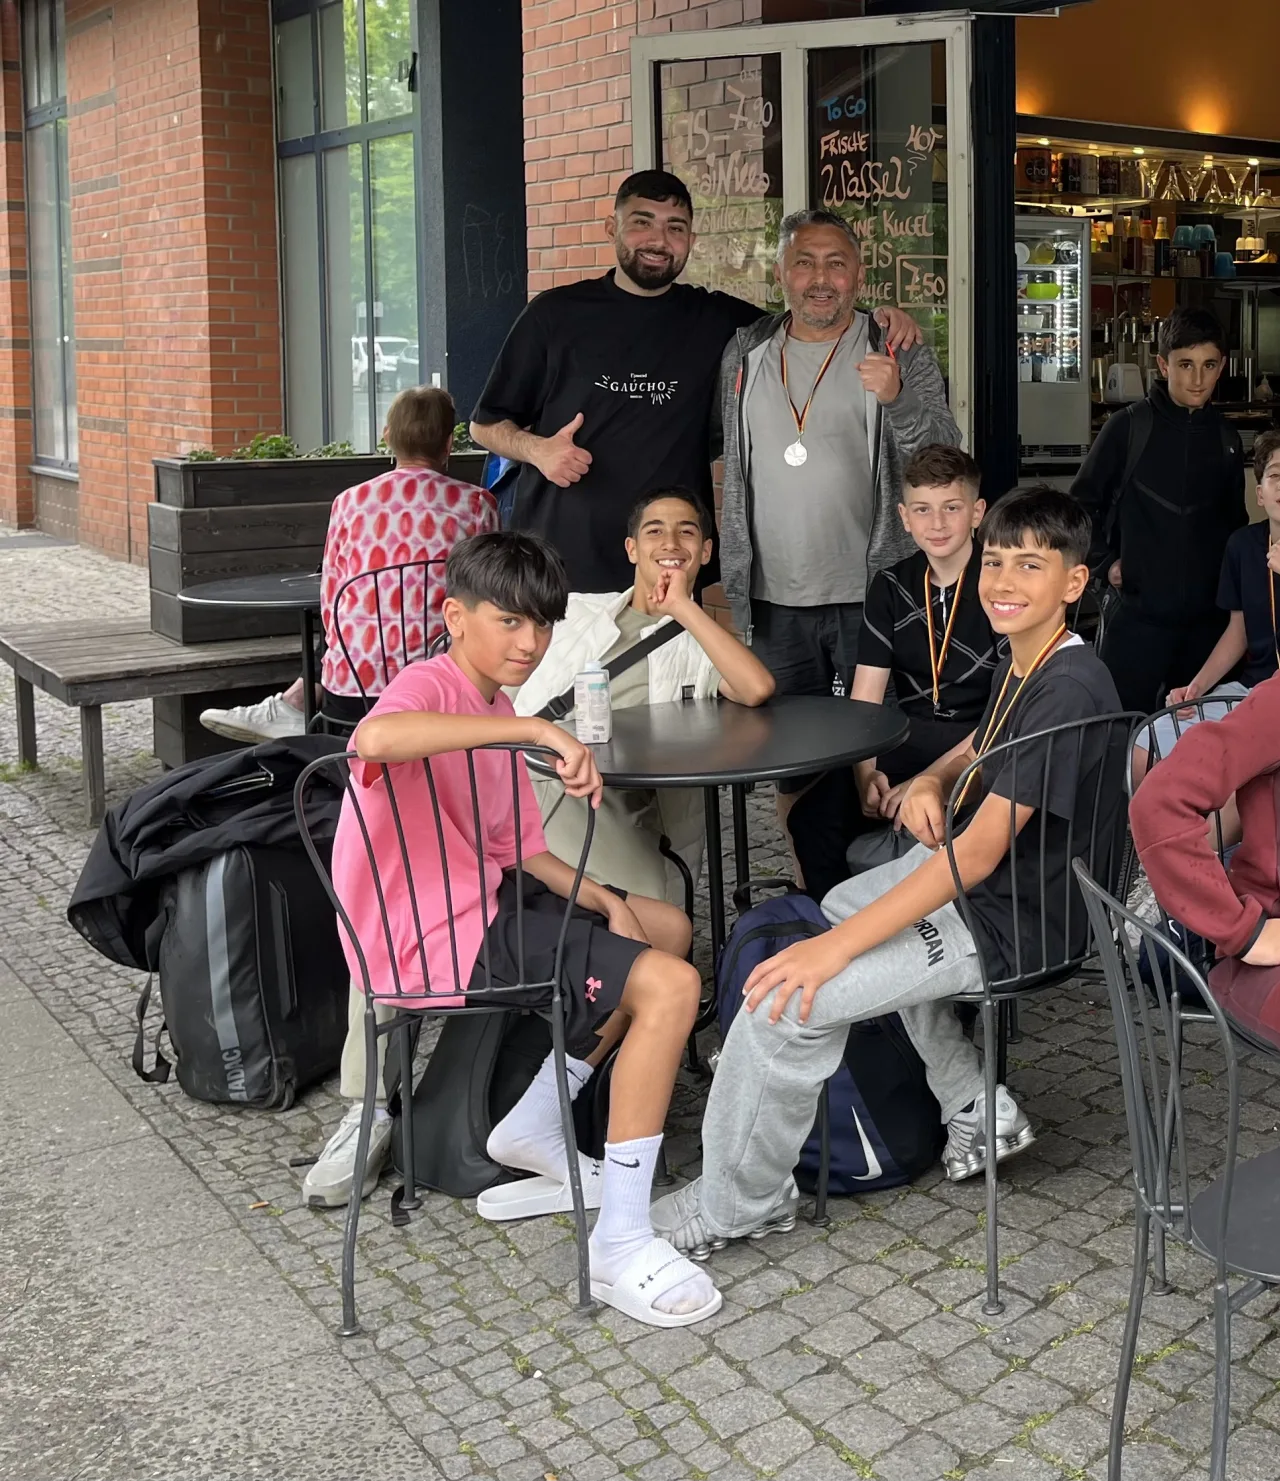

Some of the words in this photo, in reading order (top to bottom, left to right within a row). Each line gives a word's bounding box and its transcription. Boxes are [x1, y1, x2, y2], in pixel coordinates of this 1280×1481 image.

[821, 130, 869, 160] FRISCHE
[905, 124, 943, 153] HOT
[860, 241, 893, 268] EIS
[857, 282, 893, 301] AUCE
